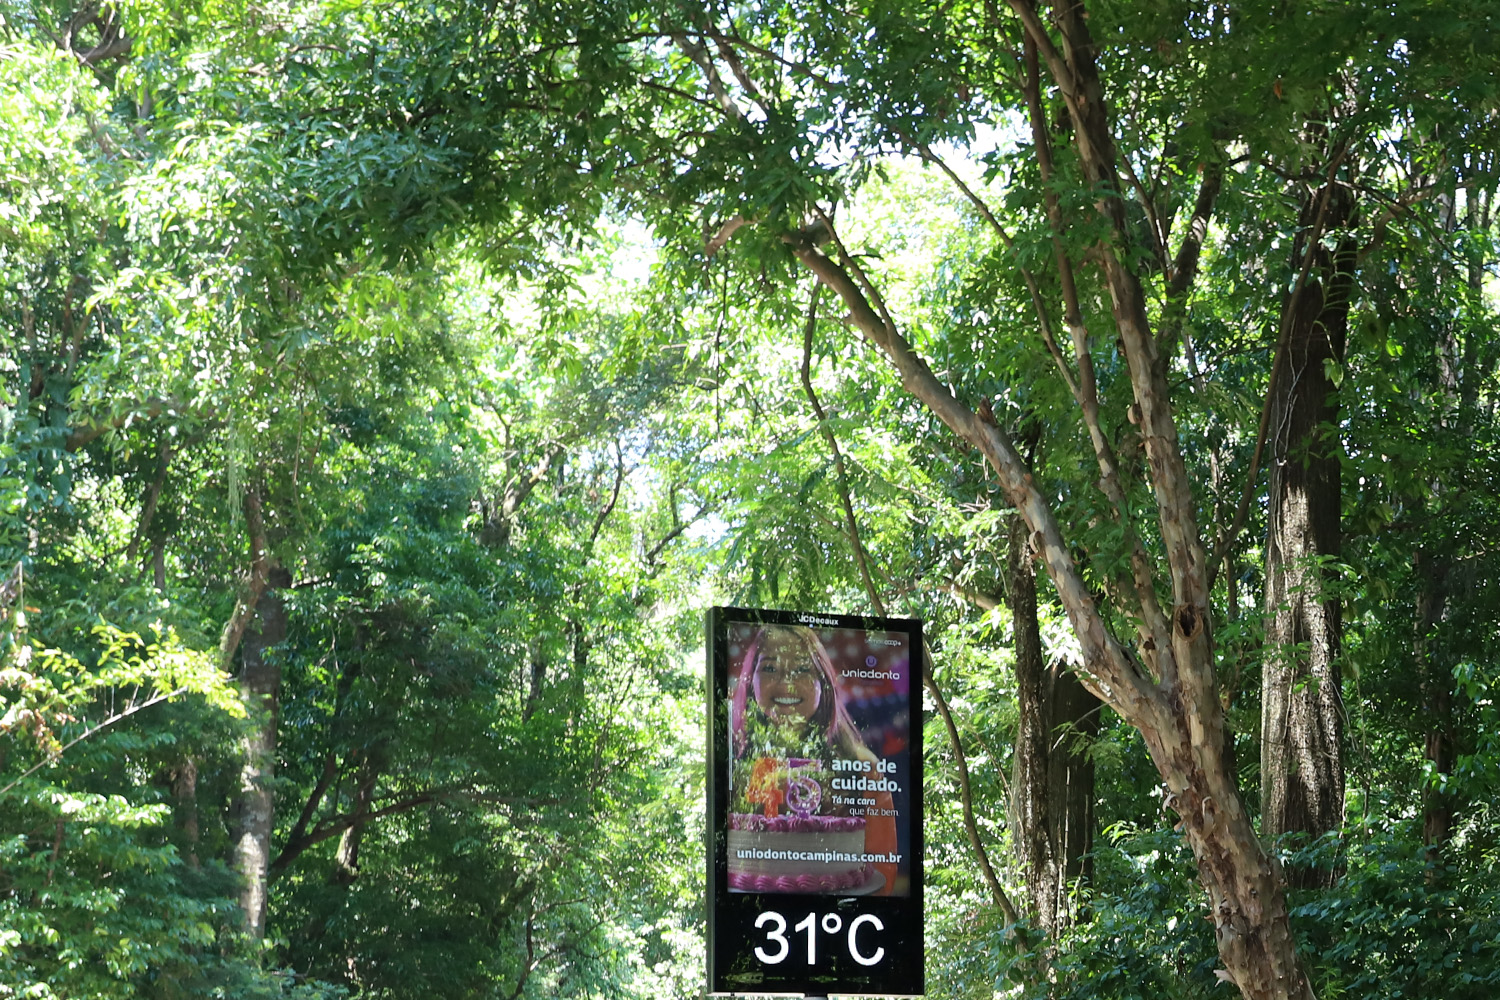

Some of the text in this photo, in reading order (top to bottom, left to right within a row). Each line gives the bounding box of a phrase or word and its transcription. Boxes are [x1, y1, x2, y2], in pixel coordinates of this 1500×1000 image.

[799, 614, 839, 625] JCDecaux
[842, 668, 900, 681] uniodonto
[831, 758, 897, 773] anos de
[831, 775, 902, 792] cuidado.
[831, 795, 876, 806] Tá na cara
[849, 807, 865, 817] que
[866, 807, 879, 816] faz
[736, 847, 903, 864] uniodontocampinas.com.br
